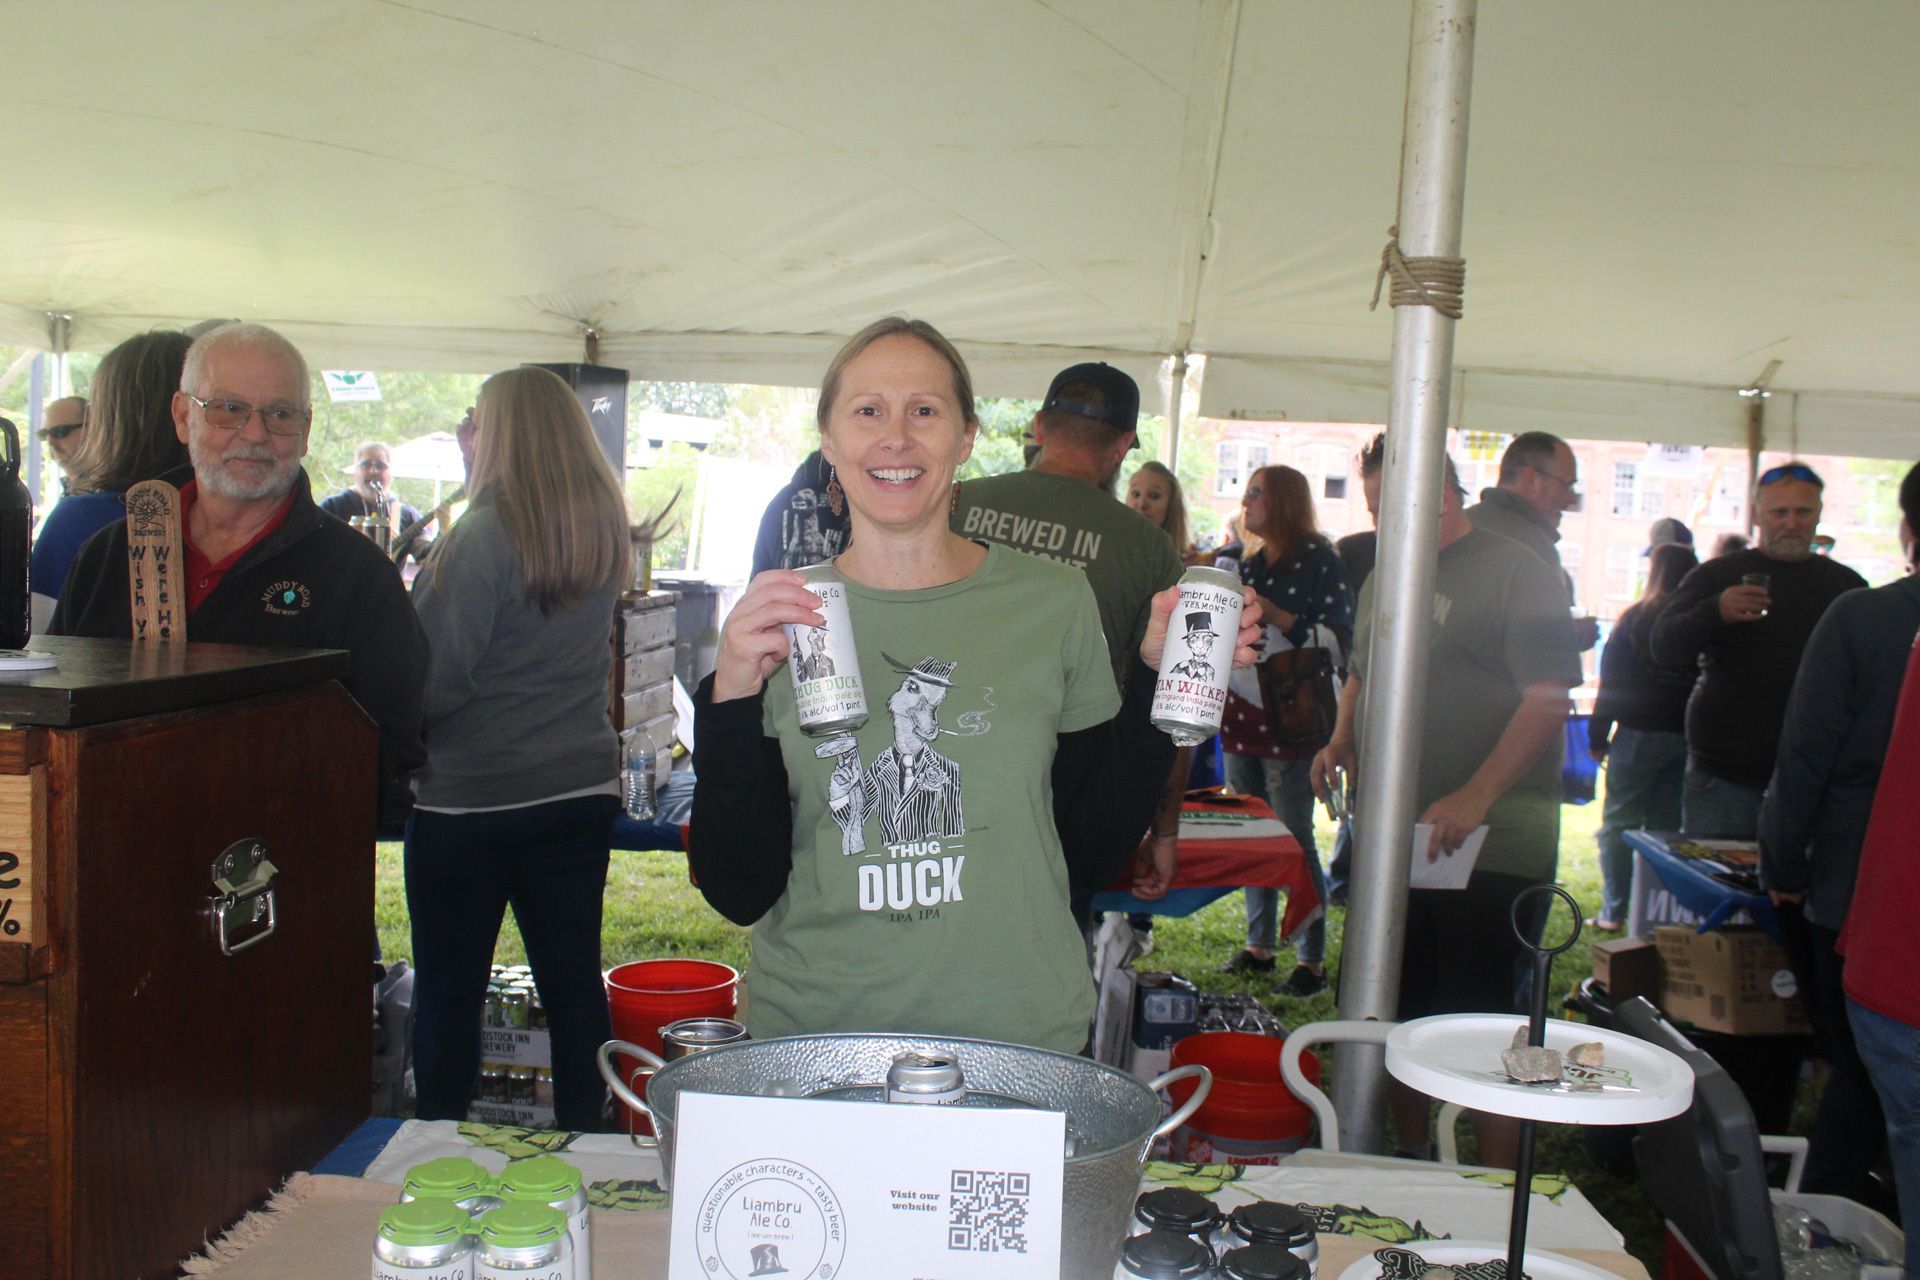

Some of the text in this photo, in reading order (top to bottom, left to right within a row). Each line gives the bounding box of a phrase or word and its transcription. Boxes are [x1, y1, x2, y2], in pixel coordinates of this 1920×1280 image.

[963, 506, 1067, 551] BREWED
[1072, 529, 1102, 560] IN
[261, 580, 310, 608] MUDDY ROAD
[1180, 589, 1211, 601] ambru
[1213, 592, 1228, 606] Ale
[825, 675, 859, 691] DUCK
[1177, 680, 1225, 703] WICKED
[809, 703, 839, 717] alc/vol
[846, 700, 861, 712] pint
[1164, 703, 1194, 714] alc/vol
[1200, 709, 1215, 720] pint
[888, 841, 941, 859] THUG
[858, 855, 965, 911] DUCK
[890, 908, 941, 923] IPA IPA
[482, 1031, 530, 1044] DSTOCK INN
[484, 1041, 517, 1053] REWERY
[518, 1108, 534, 1121] INN
[702, 1171, 745, 1234] questionable
[745, 1164, 804, 1181] characters
[814, 1185, 836, 1213] tasty
[829, 1214, 841, 1242] beer
[890, 1189, 941, 1201] Visit our
[743, 1195, 802, 1214] Liambru
[892, 1201, 938, 1212] website
[750, 1212, 771, 1228] Ale
